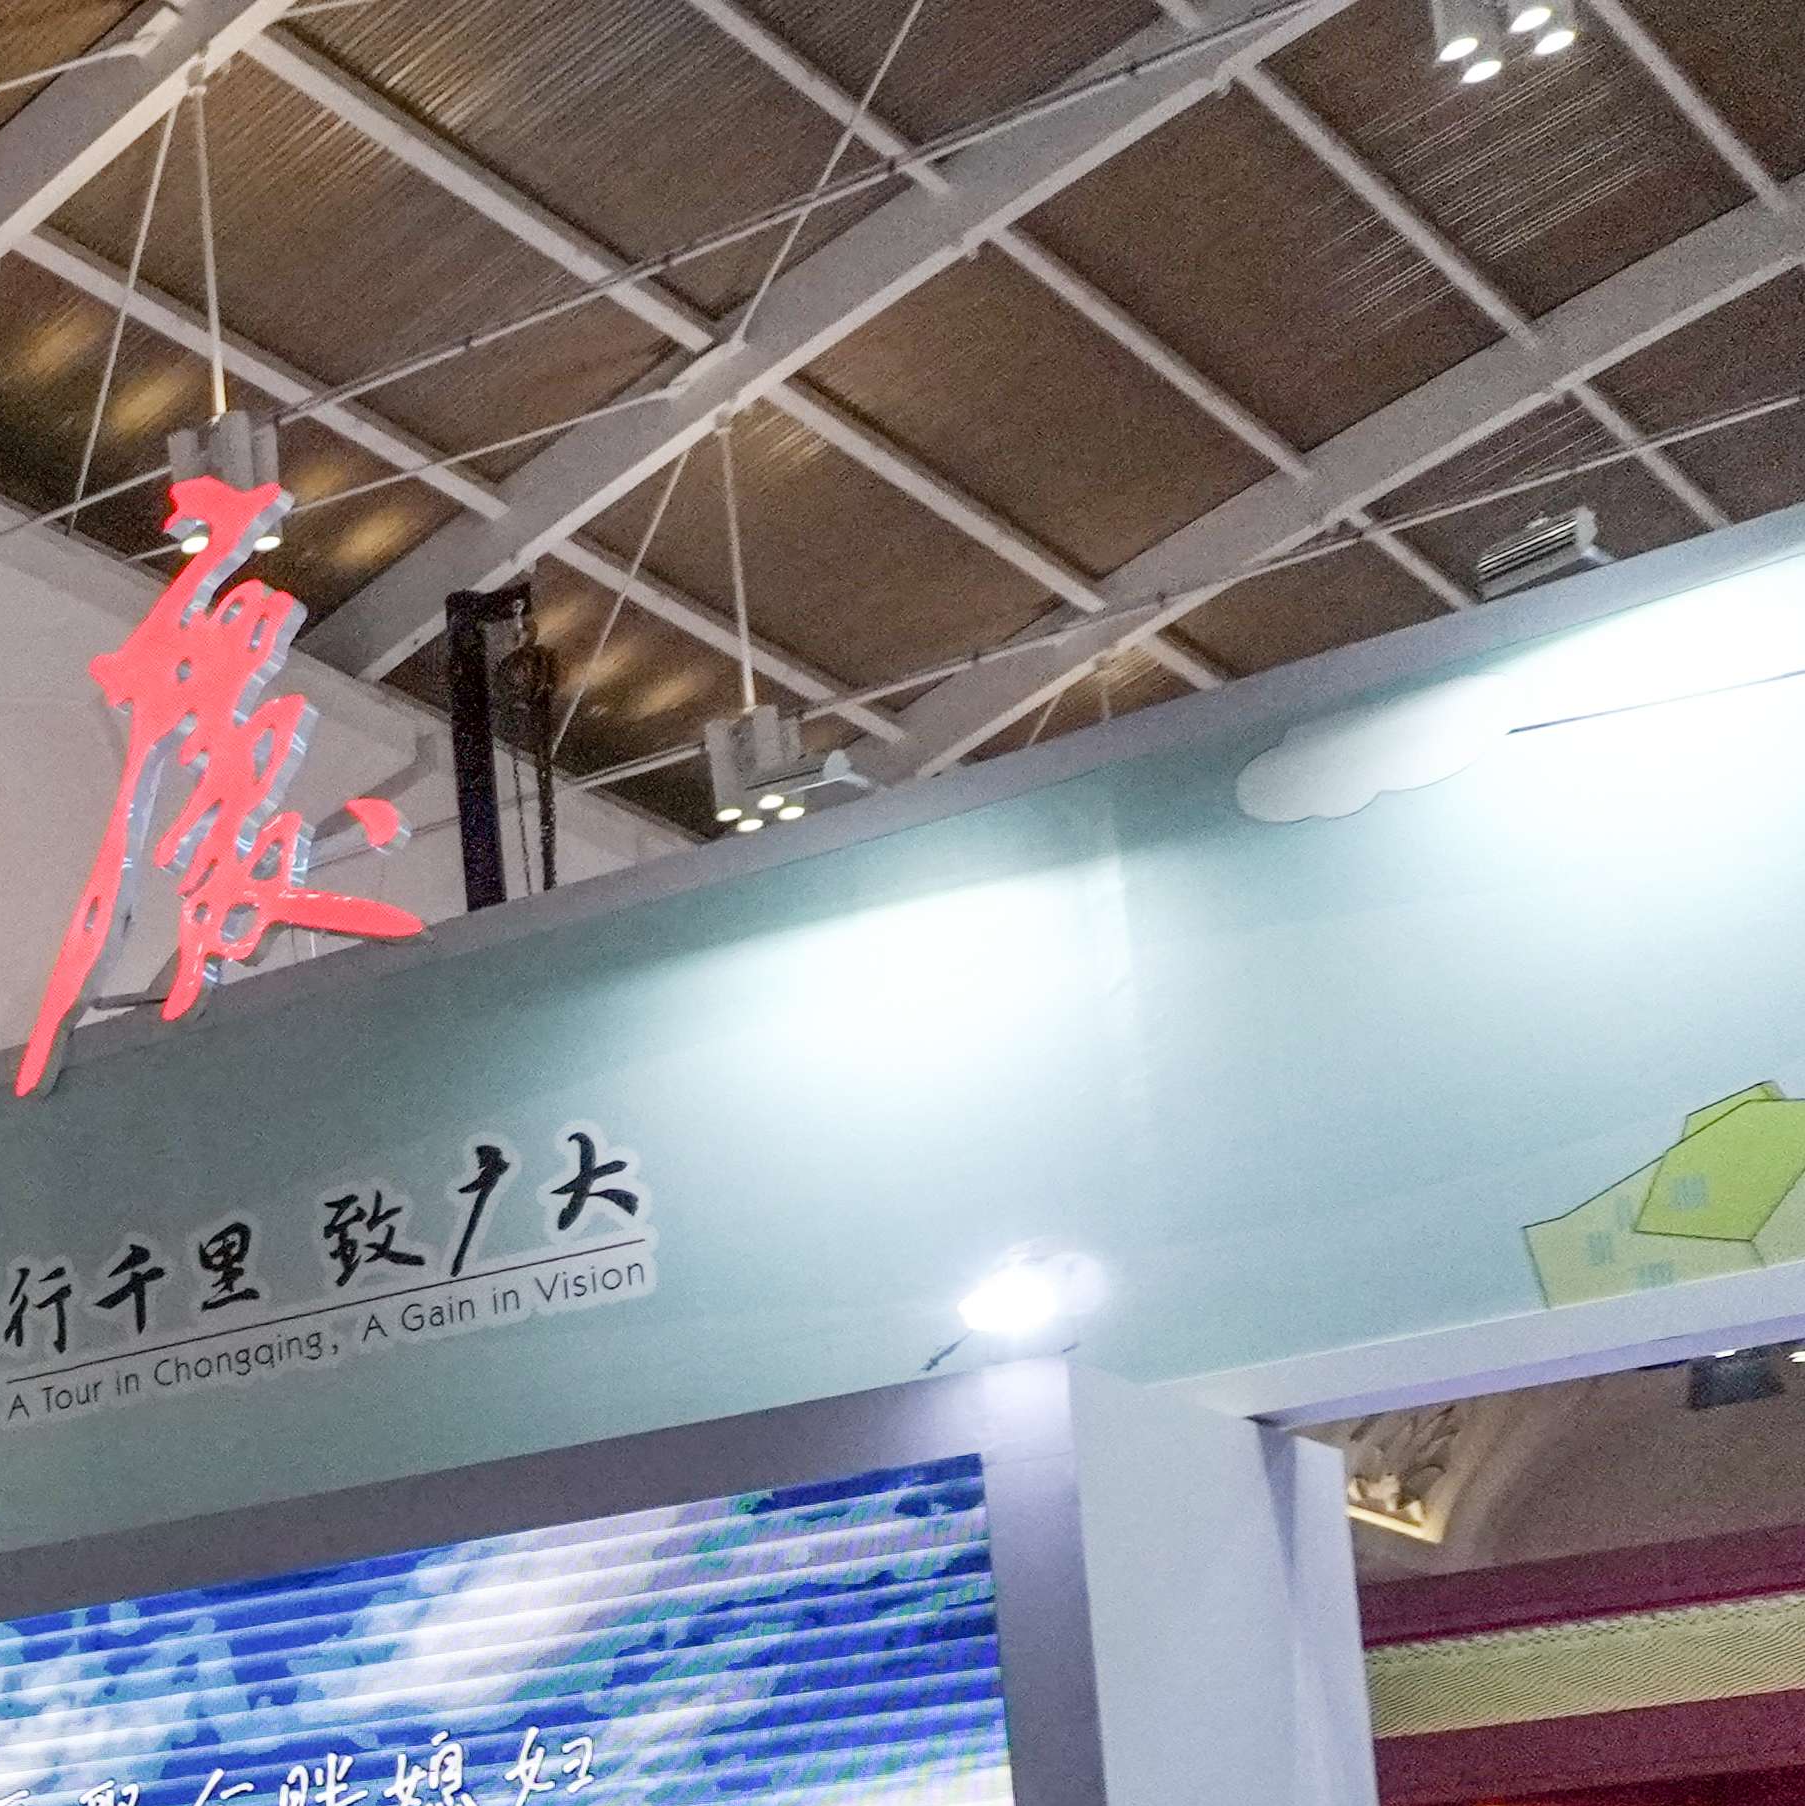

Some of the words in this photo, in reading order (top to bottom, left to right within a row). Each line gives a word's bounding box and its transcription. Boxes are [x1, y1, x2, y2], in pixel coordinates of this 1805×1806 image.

[4, 1222, 260, 1354] 行千里
[324, 1132, 640, 1287] 致广大
[7, 1394, 30, 1421] A
[43, 1380, 101, 1413] Tour
[115, 1371, 141, 1397] in
[363, 1314, 388, 1342] A
[401, 1297, 476, 1333] Gain
[492, 1287, 521, 1315] in
[534, 1261, 646, 1302] Vision
